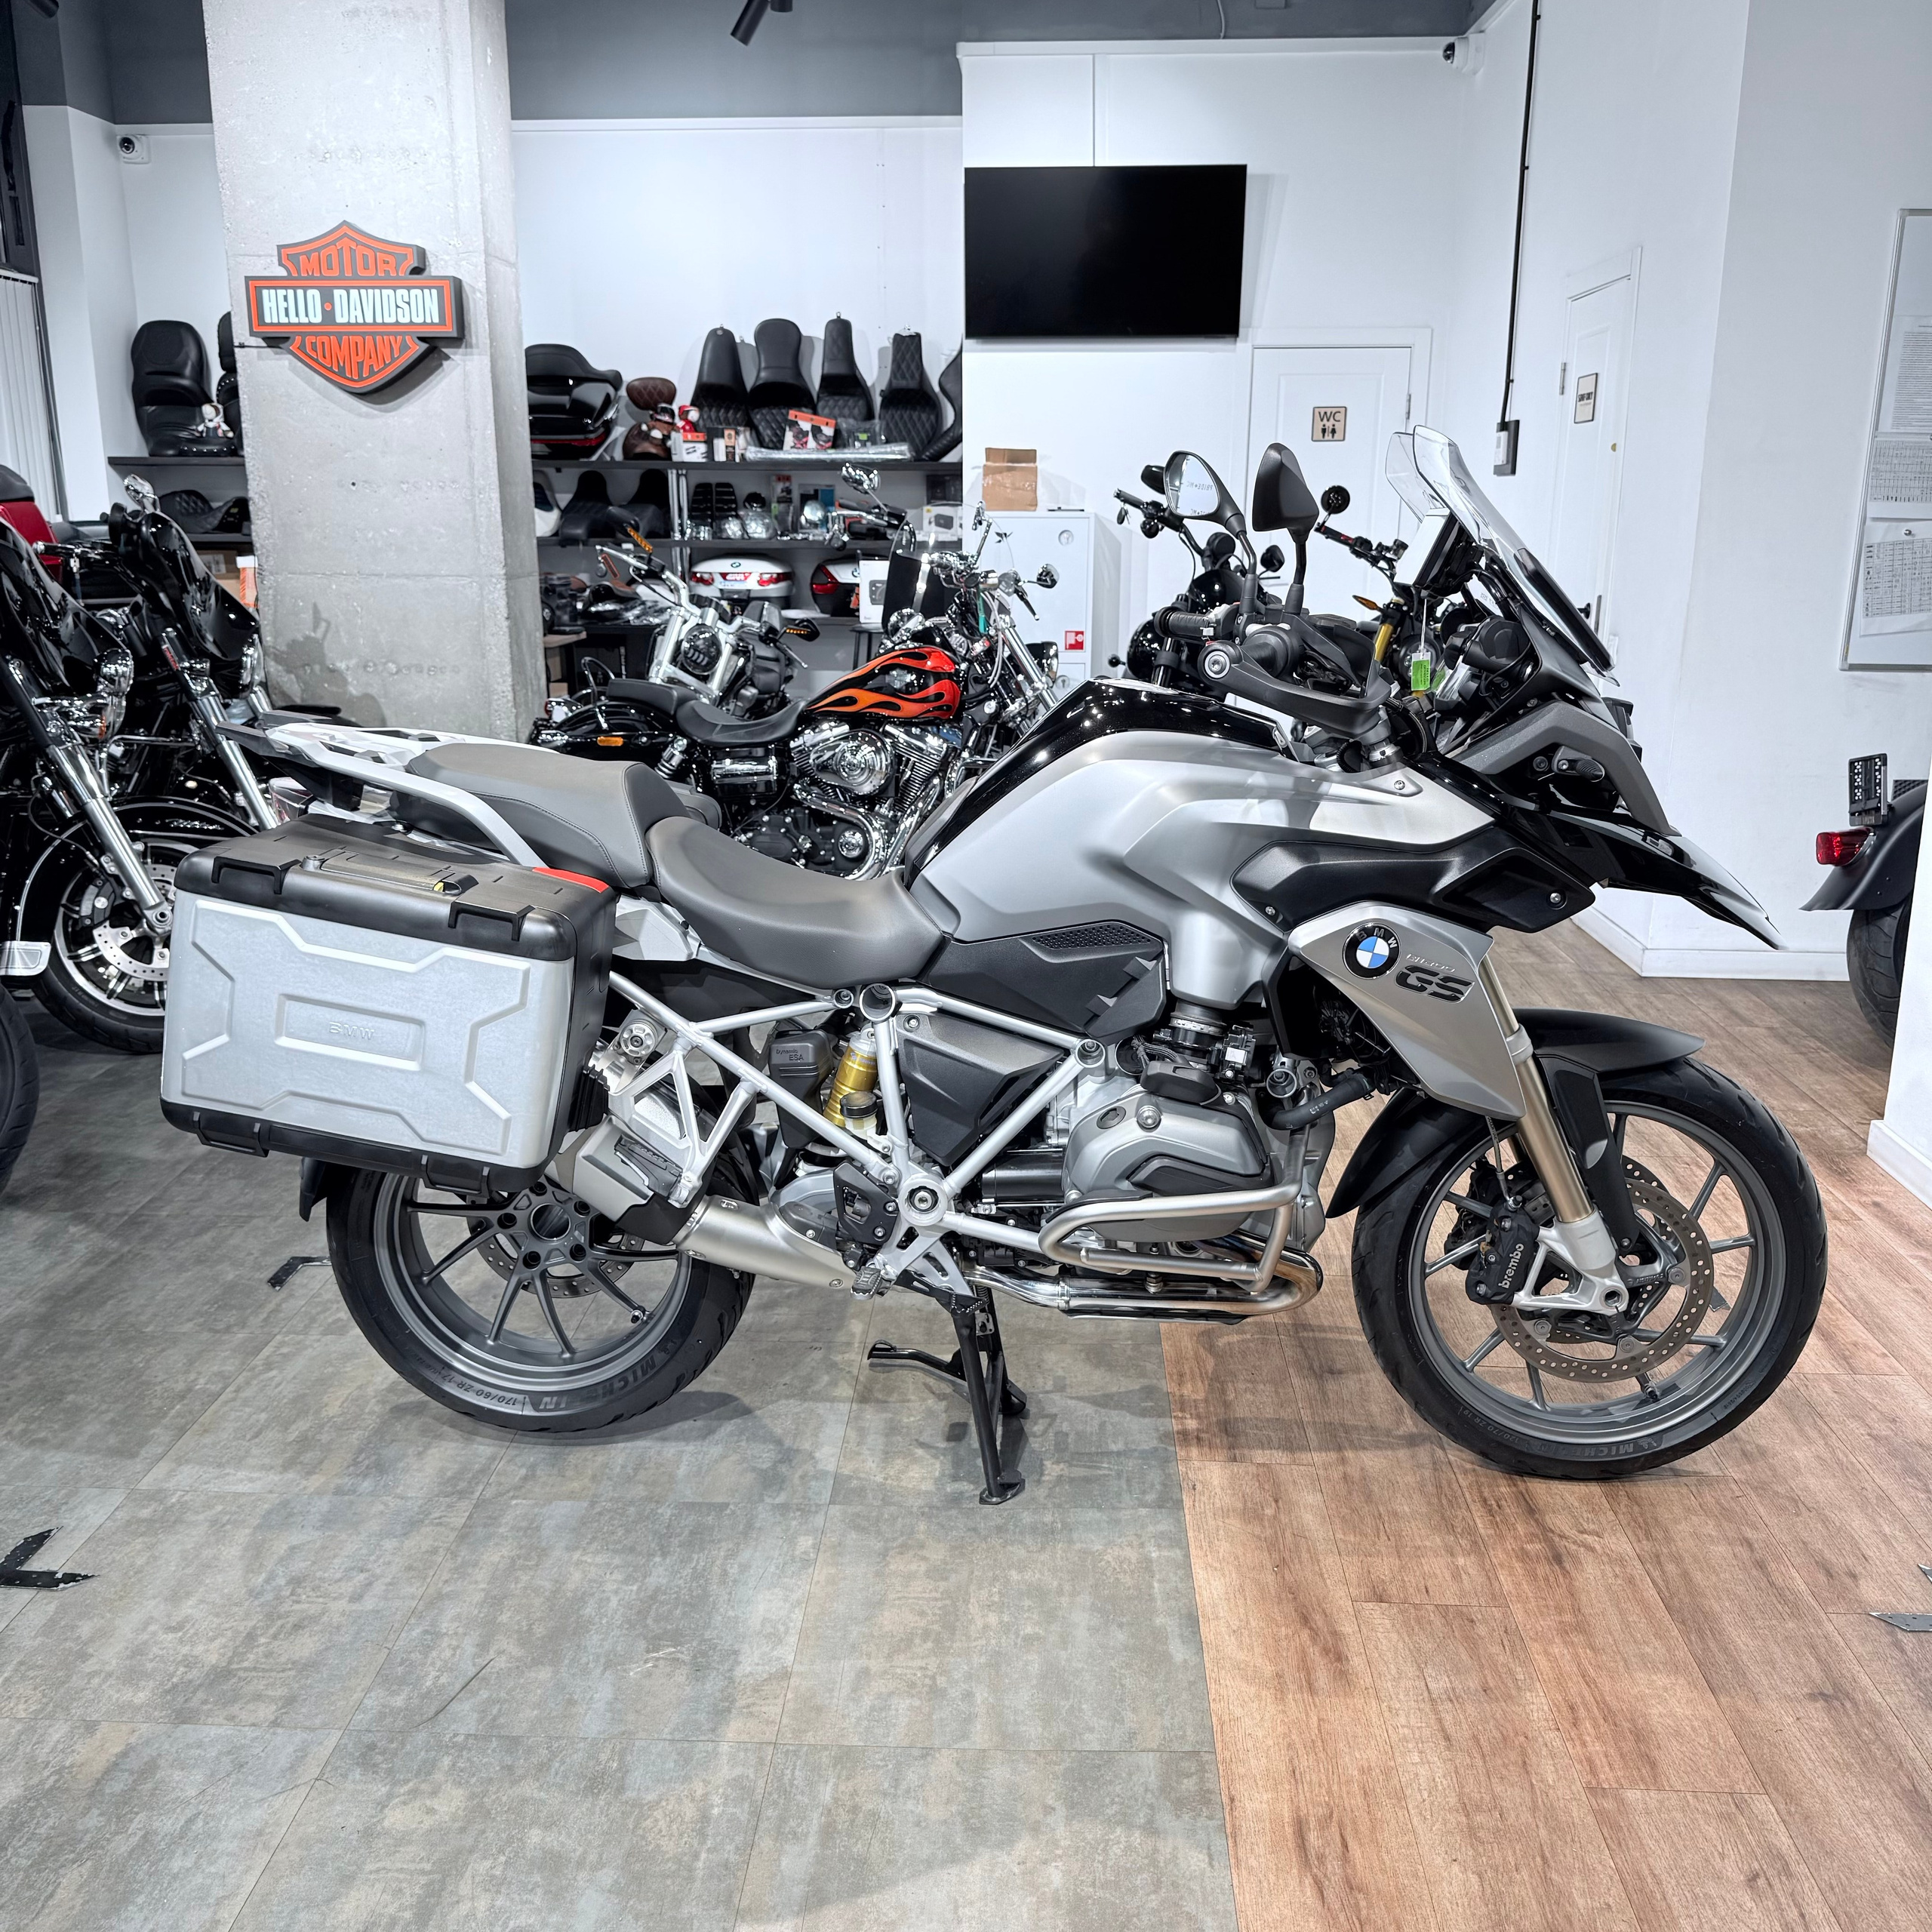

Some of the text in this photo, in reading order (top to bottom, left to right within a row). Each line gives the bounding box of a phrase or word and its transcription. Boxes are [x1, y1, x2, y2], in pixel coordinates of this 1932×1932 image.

[300, 236, 397, 276] MOTOR
[262, 288, 439, 323] HELLO DAVIDSON
[305, 335, 402, 379] COMPANY
[1318, 411, 1341, 423] WC
[1356, 927, 1398, 949] BMW
[1395, 964, 1475, 1004] GS
[329, 1021, 375, 1040] BMW
[1498, 1243, 1524, 1289] brembo
[441, 1374, 518, 1405] 170/60 ZR 17
[538, 1355, 657, 1409] MICHEIN
[1474, 1417, 1487, 1426] ZR
[1487, 1425, 1519, 1443] 120/70
